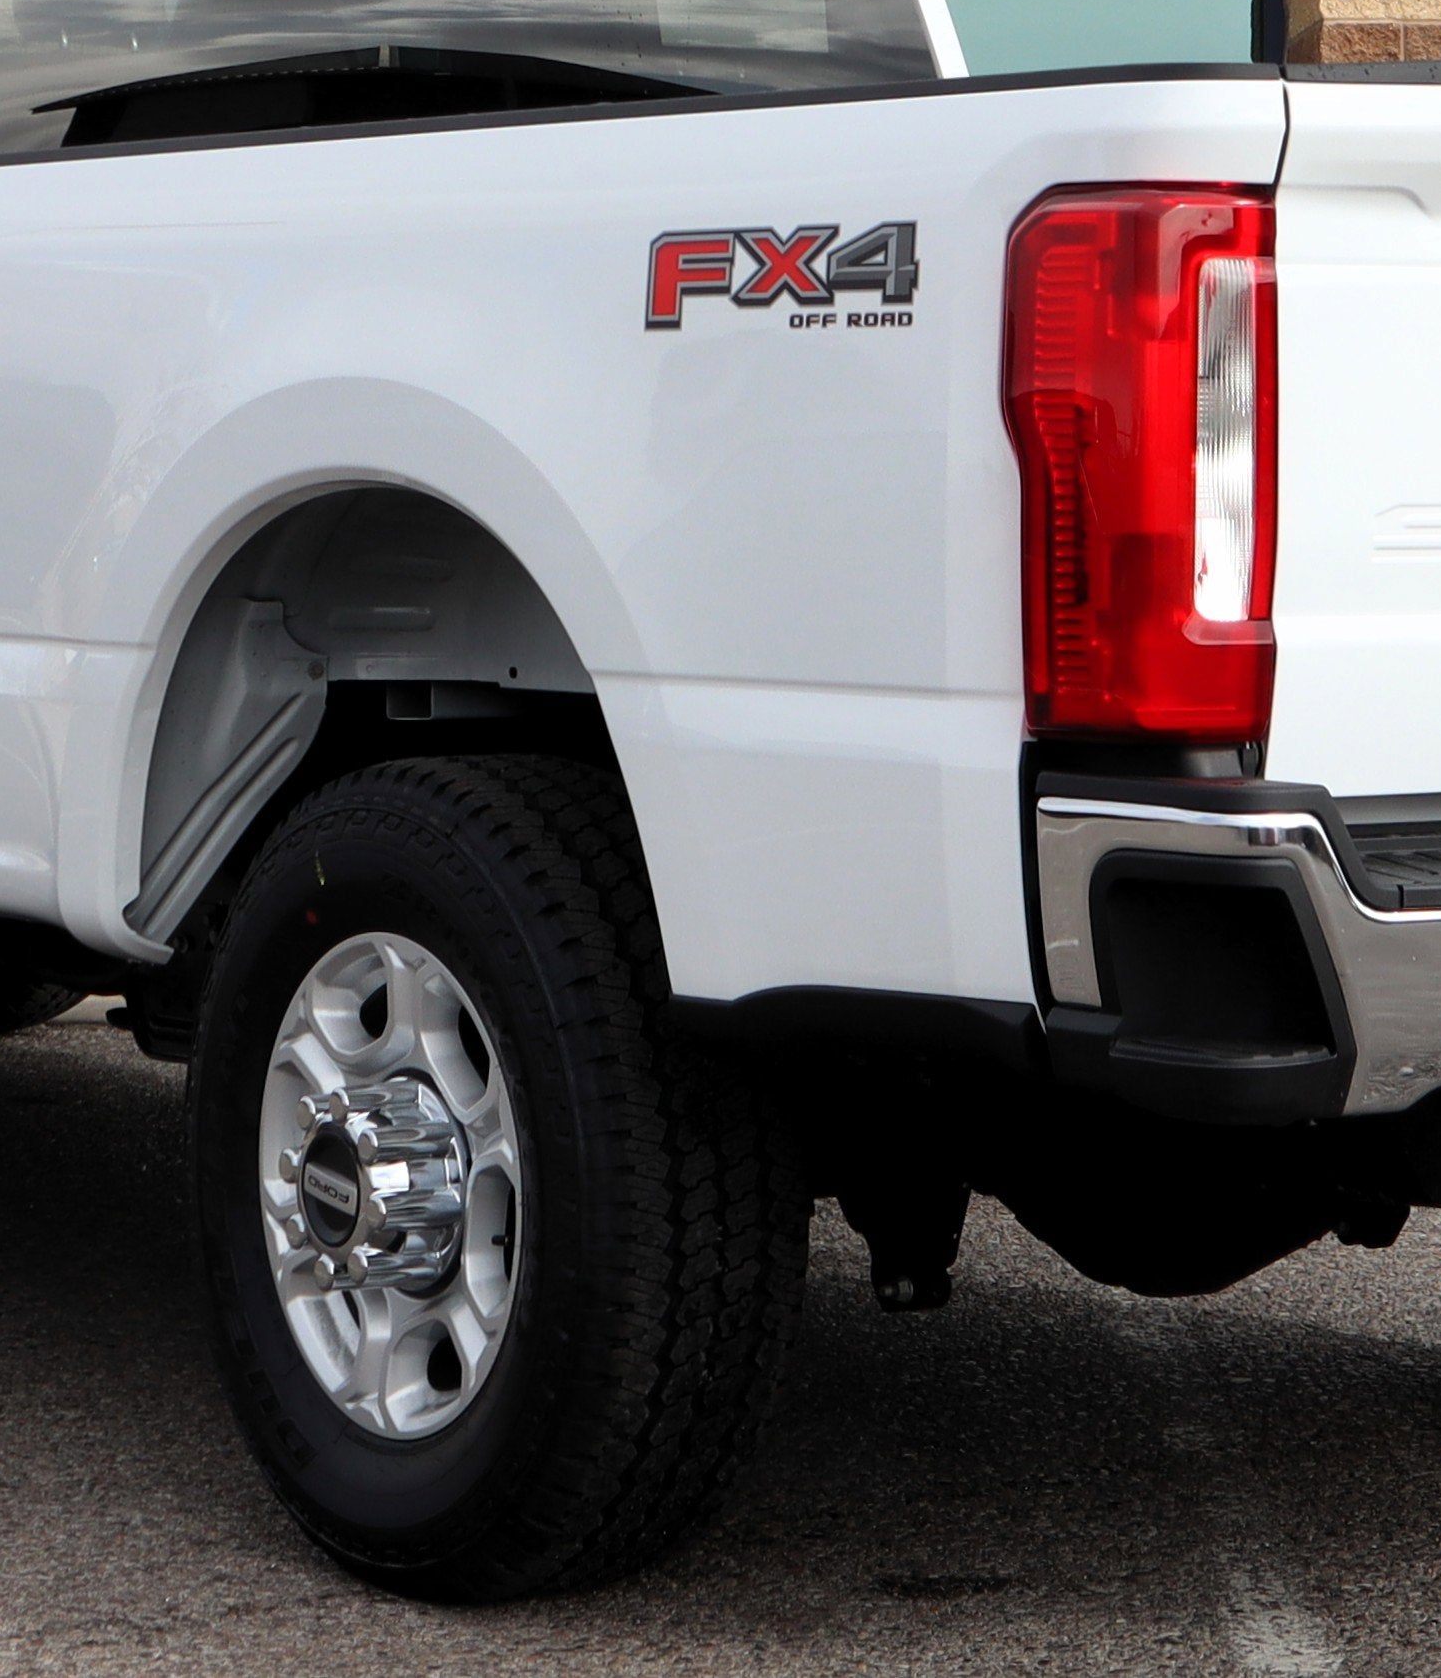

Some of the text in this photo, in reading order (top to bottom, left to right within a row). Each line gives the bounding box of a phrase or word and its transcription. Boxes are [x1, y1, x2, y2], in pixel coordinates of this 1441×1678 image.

[645, 220, 920, 332] FX4
[788, 311, 914, 329] OFF ROAD
[308, 1174, 350, 1204] FORD
